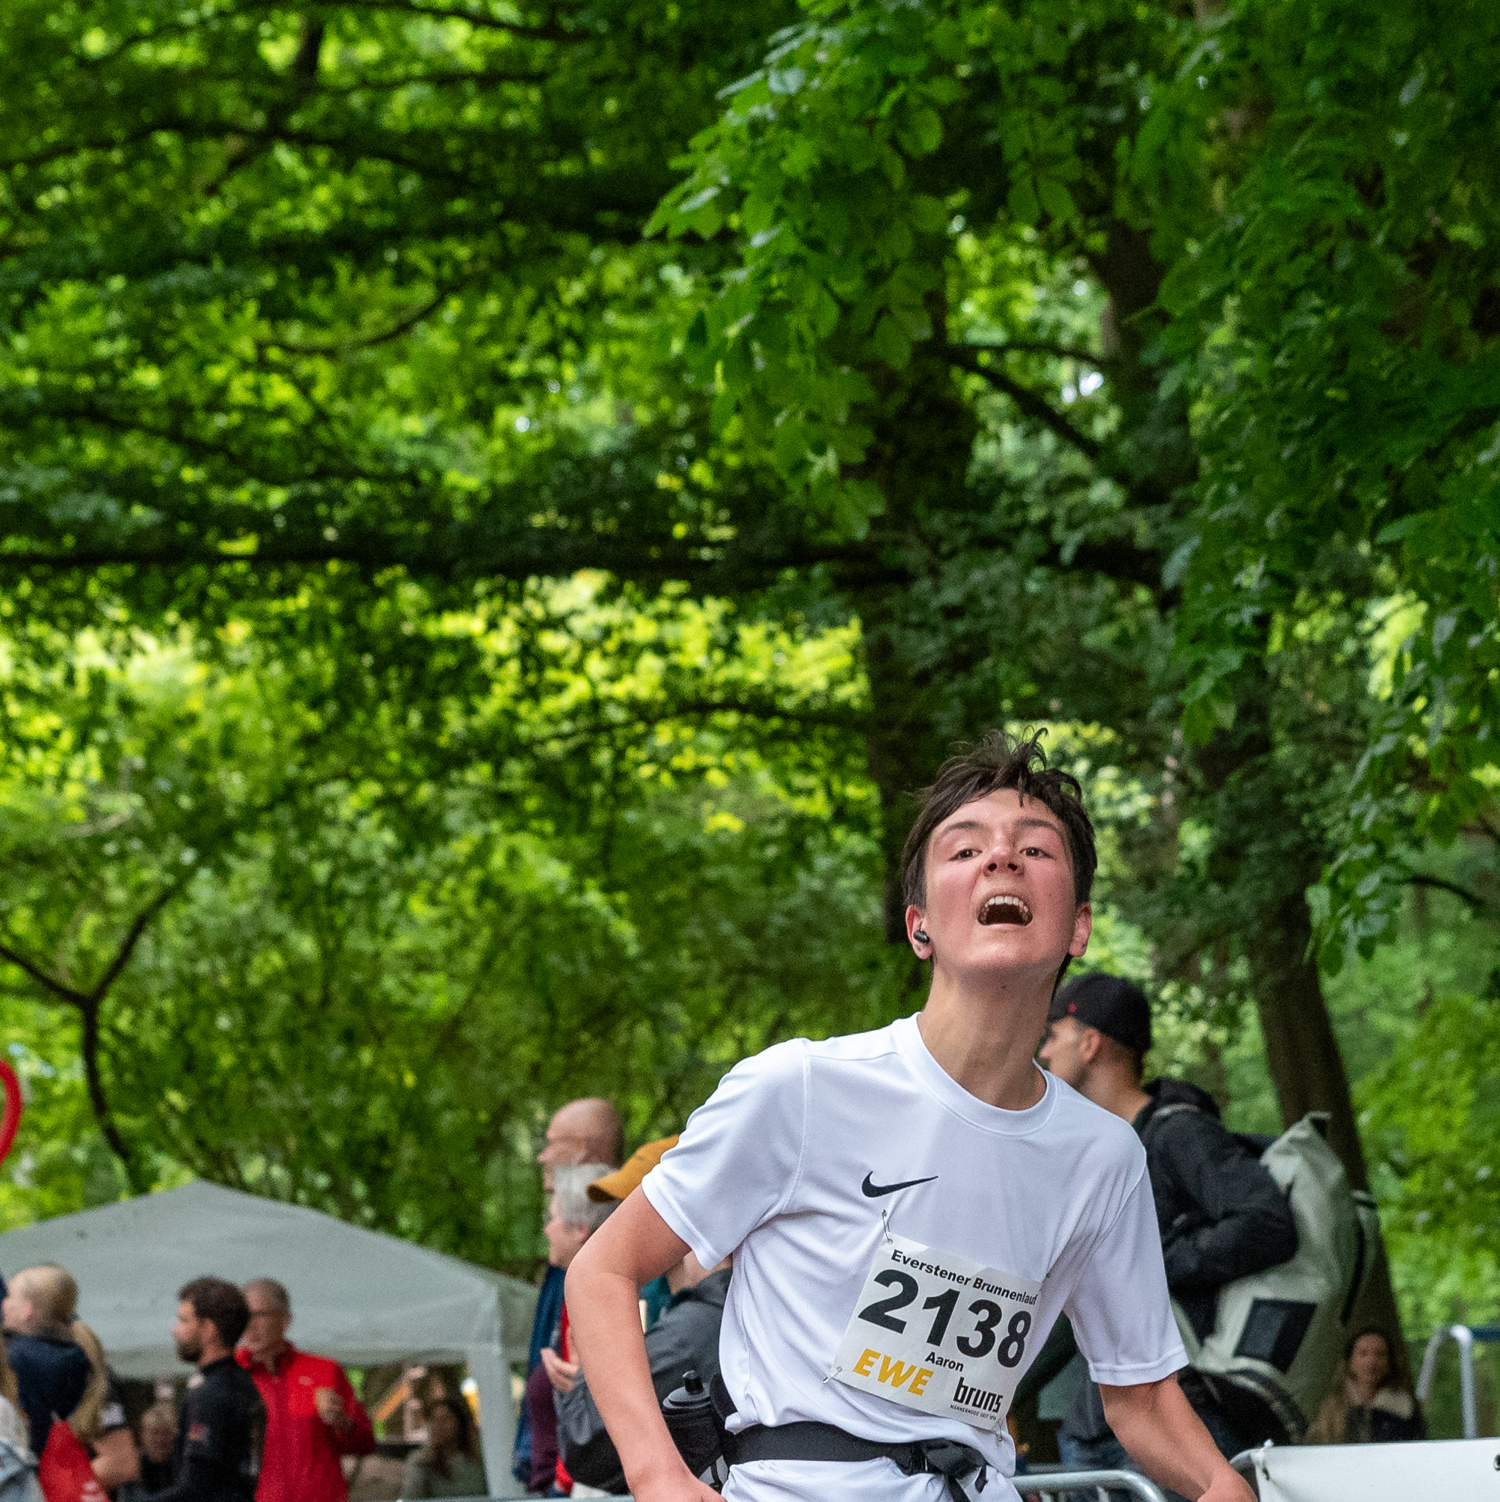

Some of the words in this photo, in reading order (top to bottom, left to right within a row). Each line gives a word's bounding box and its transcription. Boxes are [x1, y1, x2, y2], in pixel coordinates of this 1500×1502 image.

[891, 1249, 972, 1286] Everstener
[972, 1277, 1039, 1306] Brunnenlauf
[857, 1268, 1032, 1368] 2138
[853, 1348, 934, 1396] EWE
[925, 1350, 964, 1373] Aaron
[953, 1376, 1004, 1413] bruns
